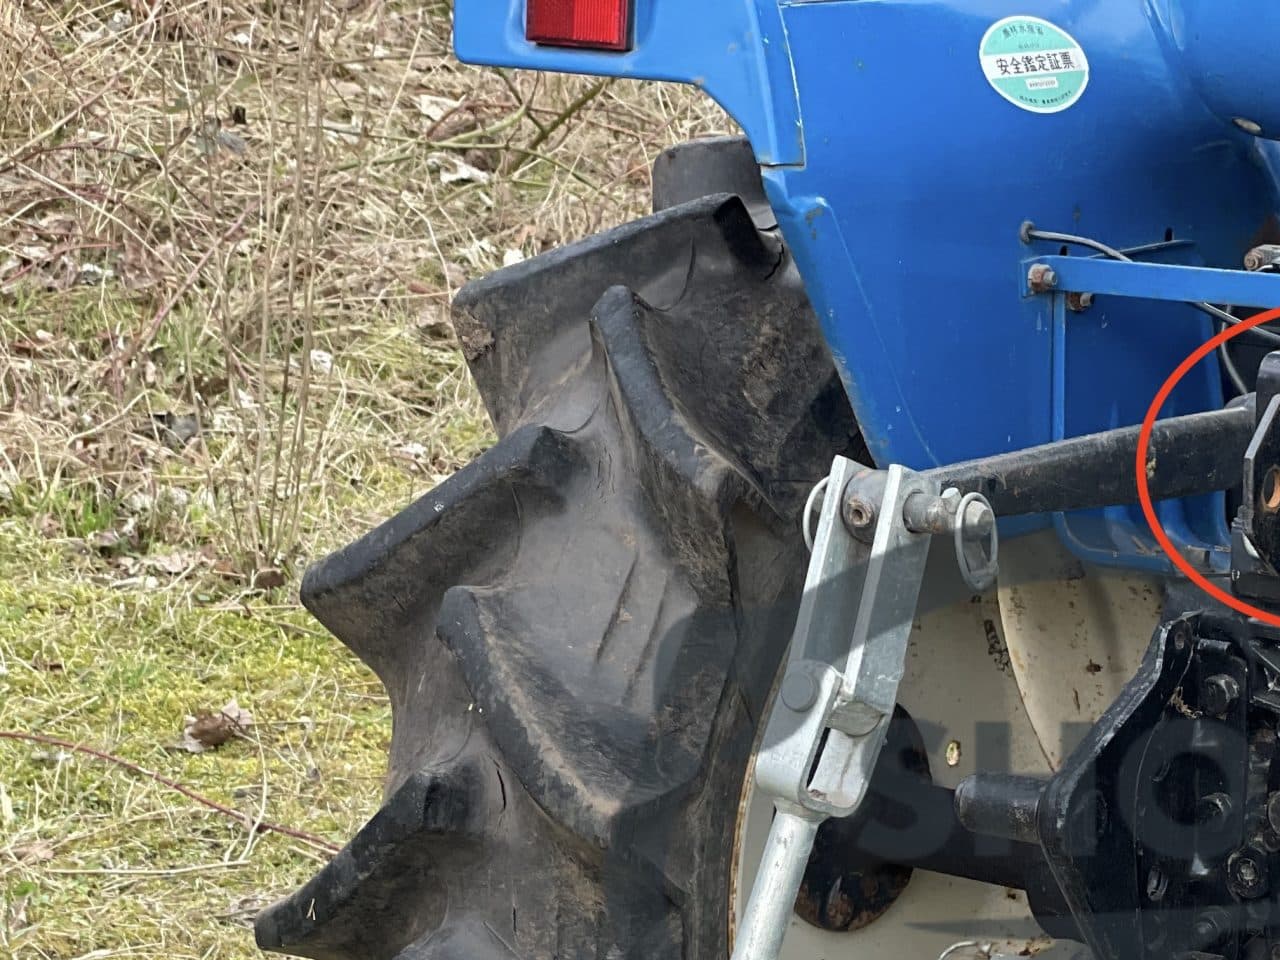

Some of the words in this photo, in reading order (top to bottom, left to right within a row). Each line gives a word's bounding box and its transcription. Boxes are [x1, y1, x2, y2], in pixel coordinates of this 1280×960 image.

[996, 51, 1075, 75] 安全鑑定証票
